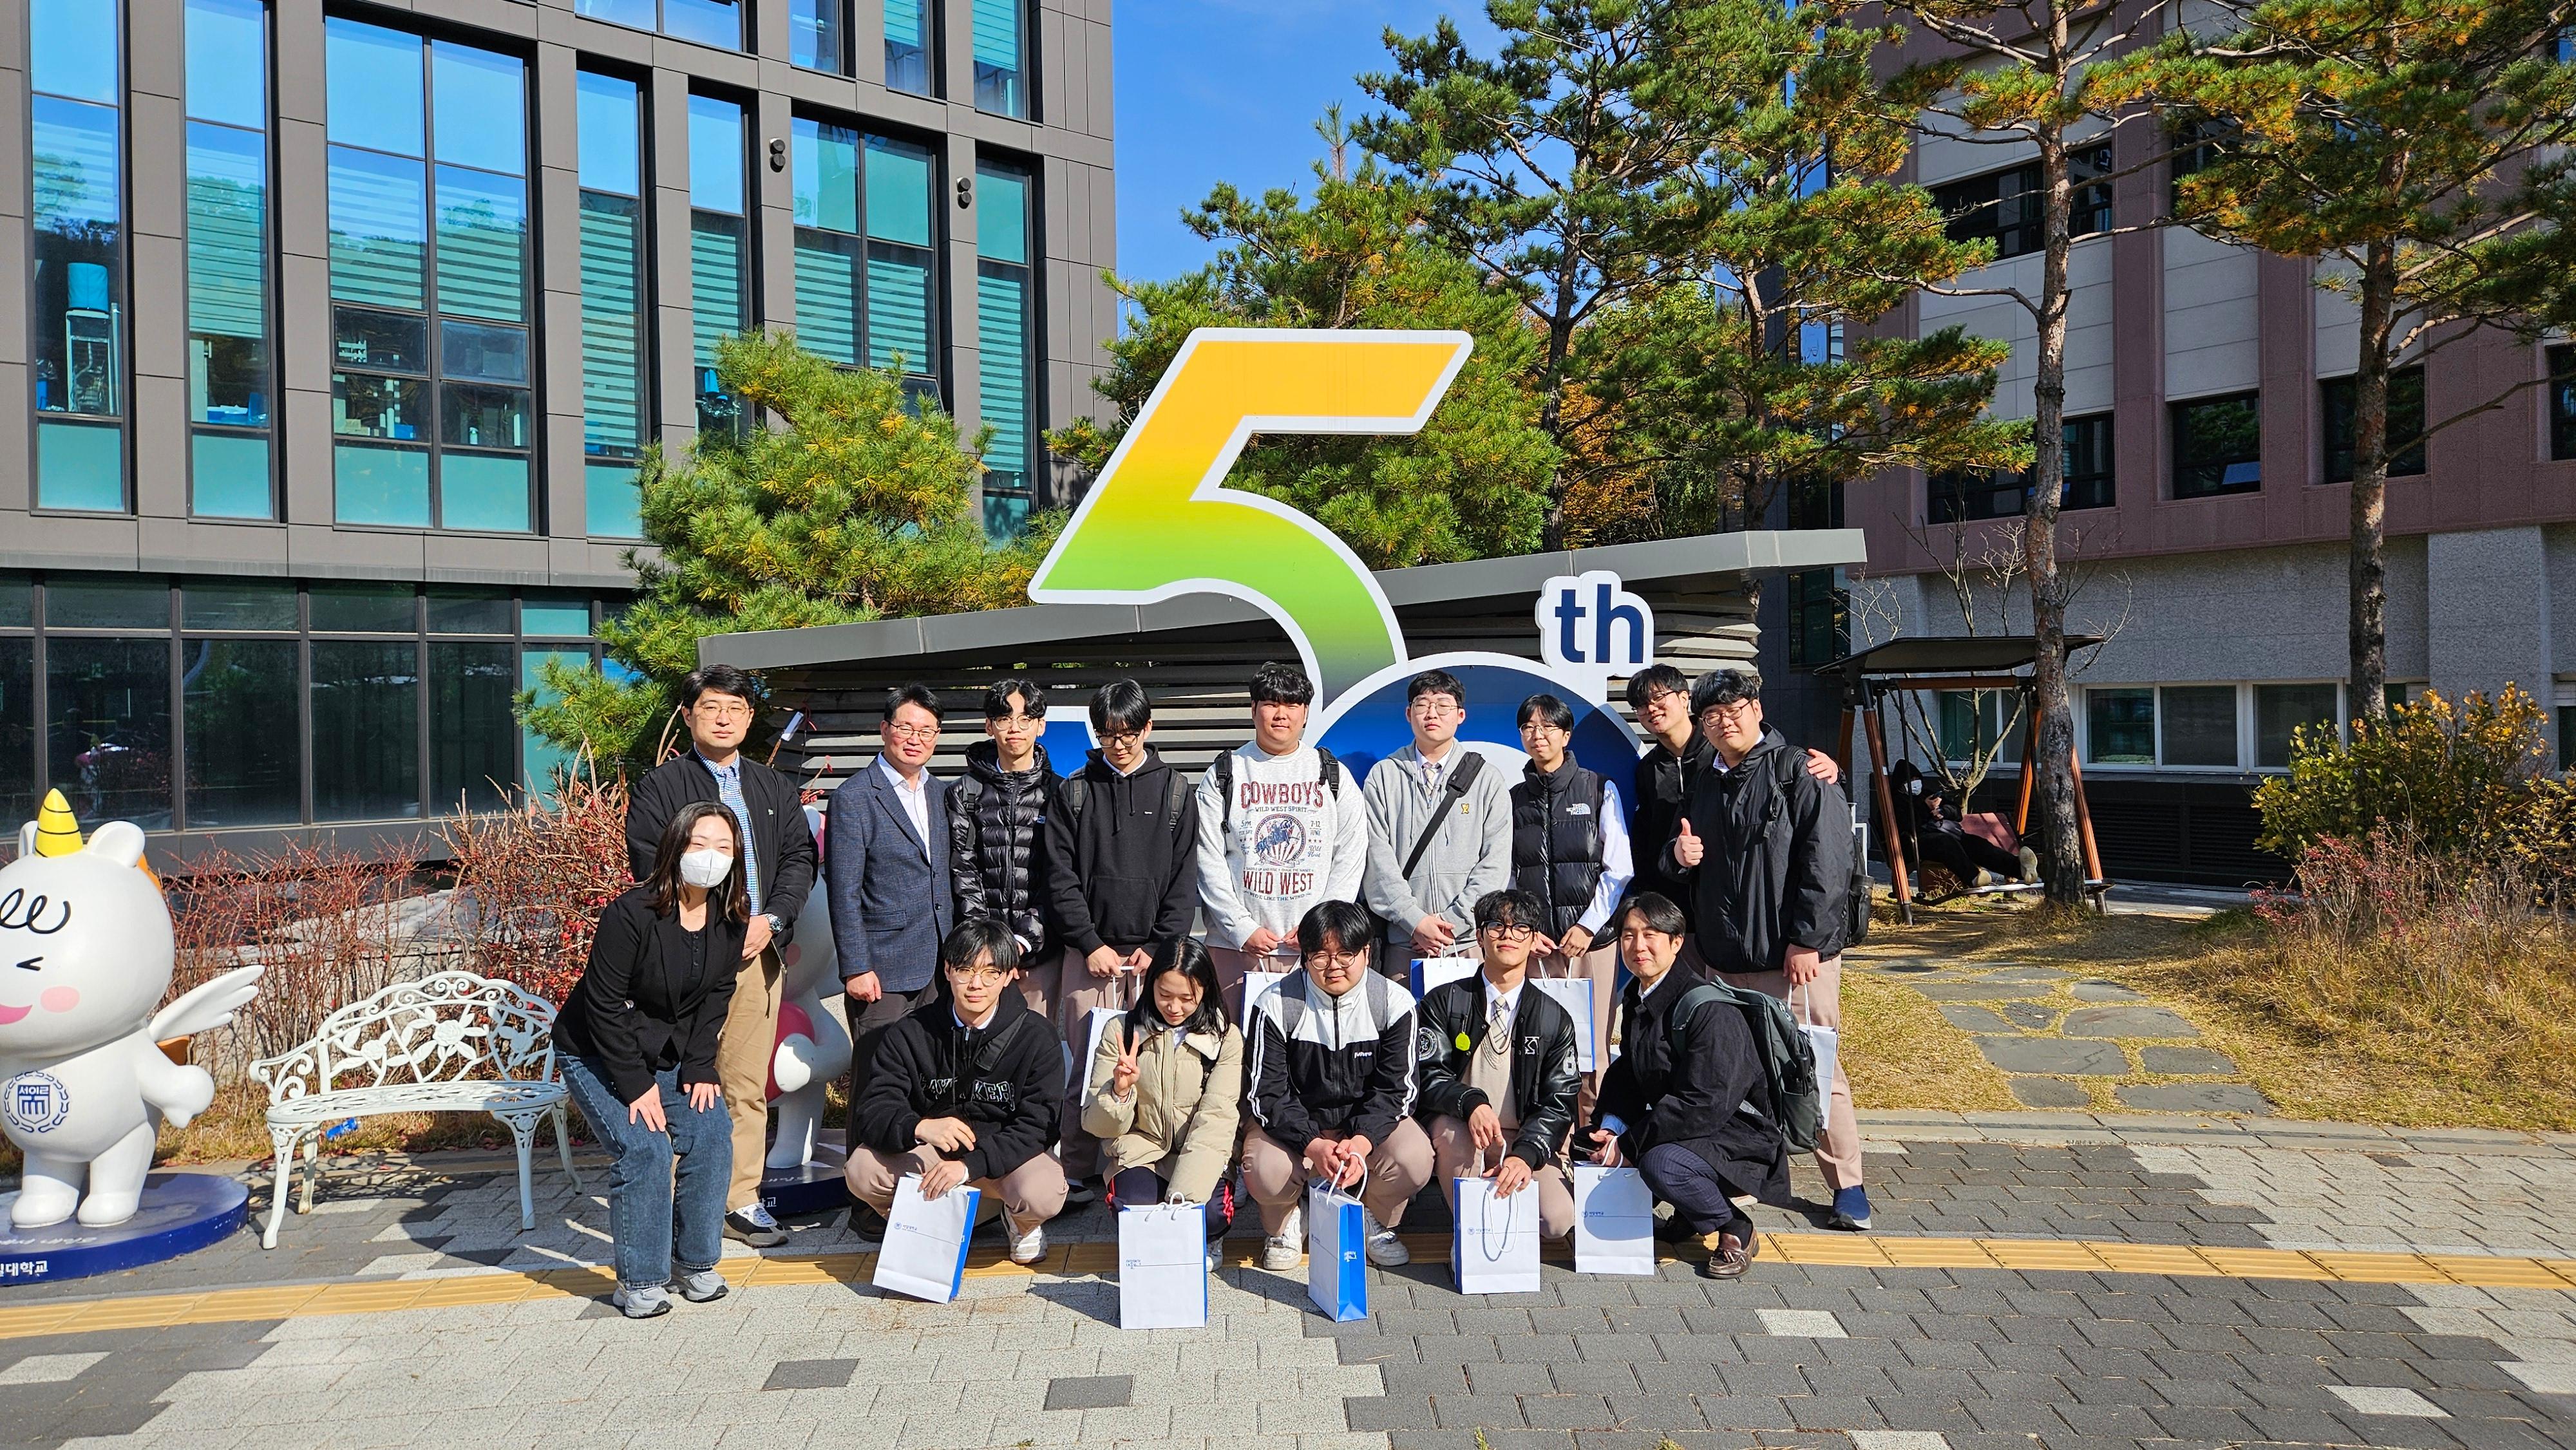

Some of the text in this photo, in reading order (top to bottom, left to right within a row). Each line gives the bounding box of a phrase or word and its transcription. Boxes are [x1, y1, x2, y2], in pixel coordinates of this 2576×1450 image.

[1554, 583, 1644, 664] th
[1240, 780, 1323, 809] COWBOYS
[1243, 871, 1314, 895] WILD WEST
